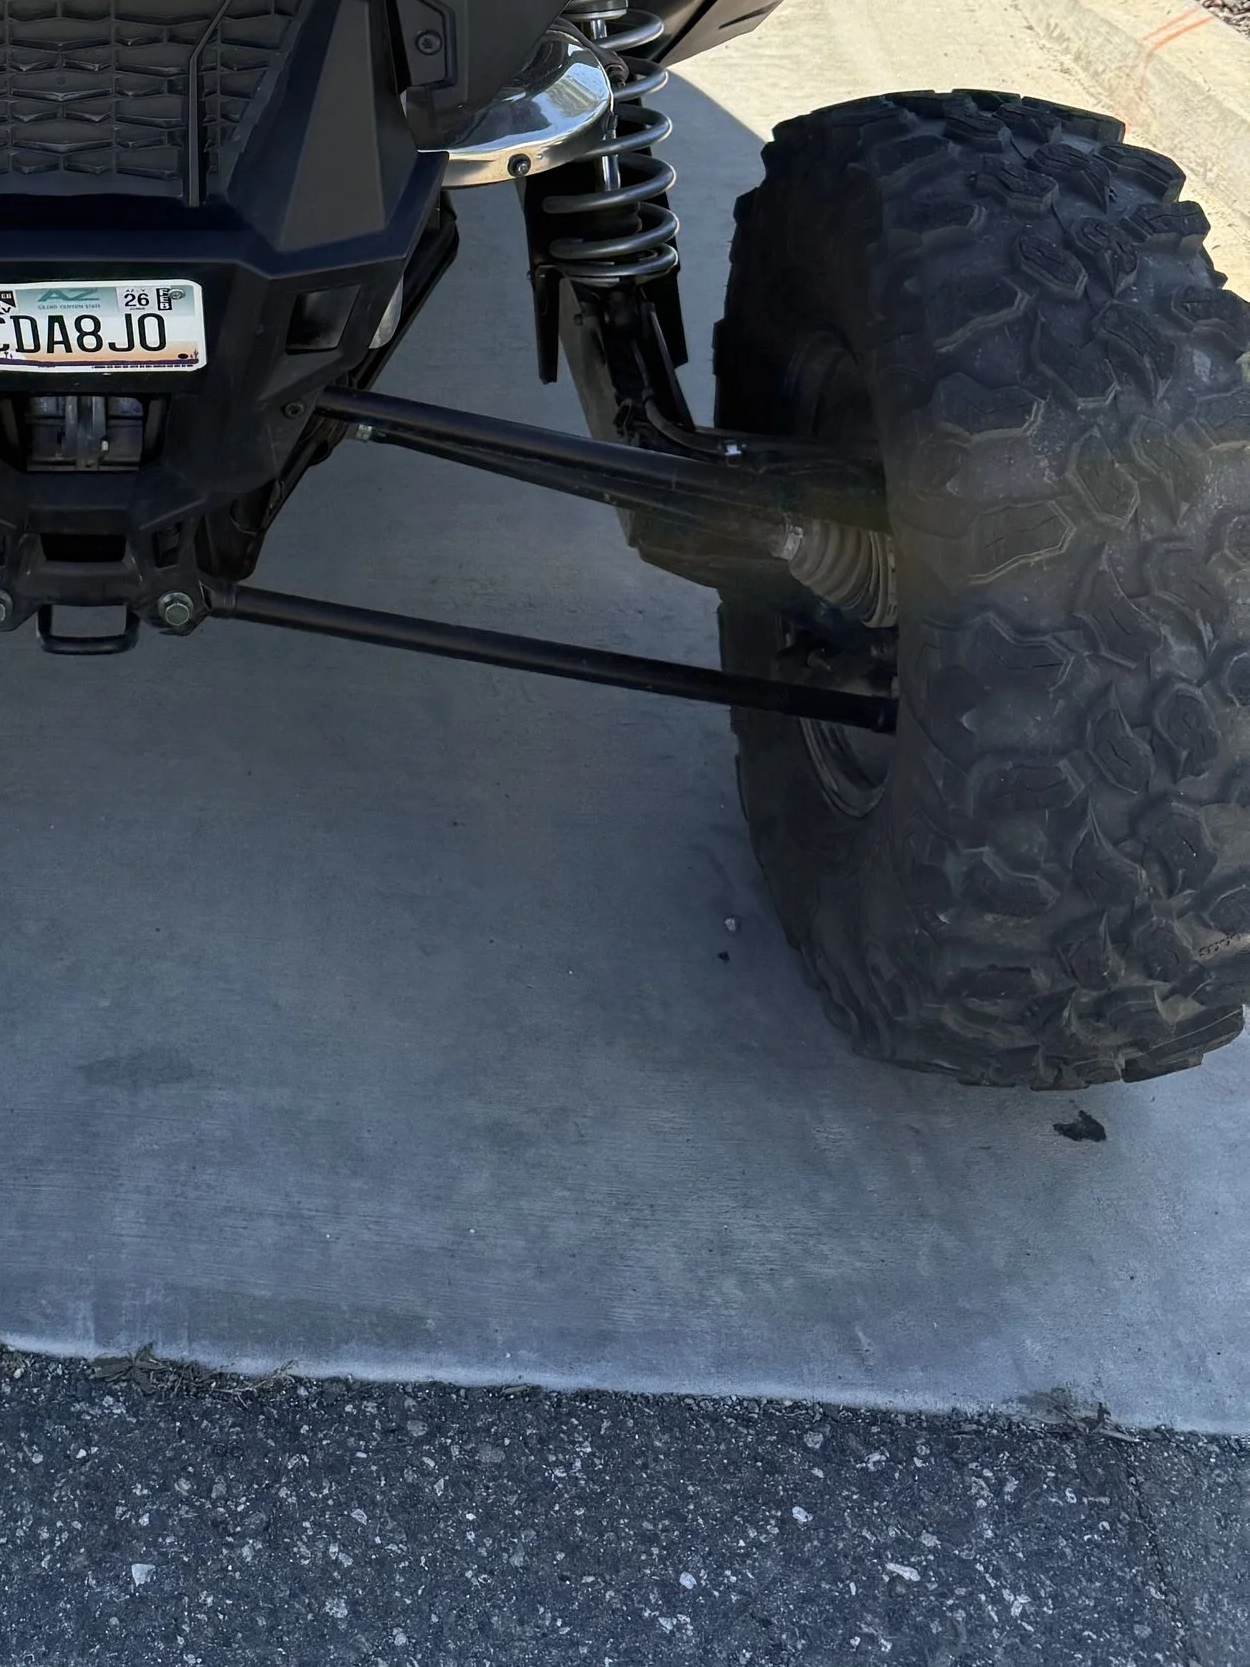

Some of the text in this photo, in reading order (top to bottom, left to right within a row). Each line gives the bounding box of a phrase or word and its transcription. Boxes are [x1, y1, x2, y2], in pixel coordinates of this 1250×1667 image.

[37, 287, 100, 303] AZ
[124, 293, 150, 307] 26
[158, 288, 170, 309] FEB
